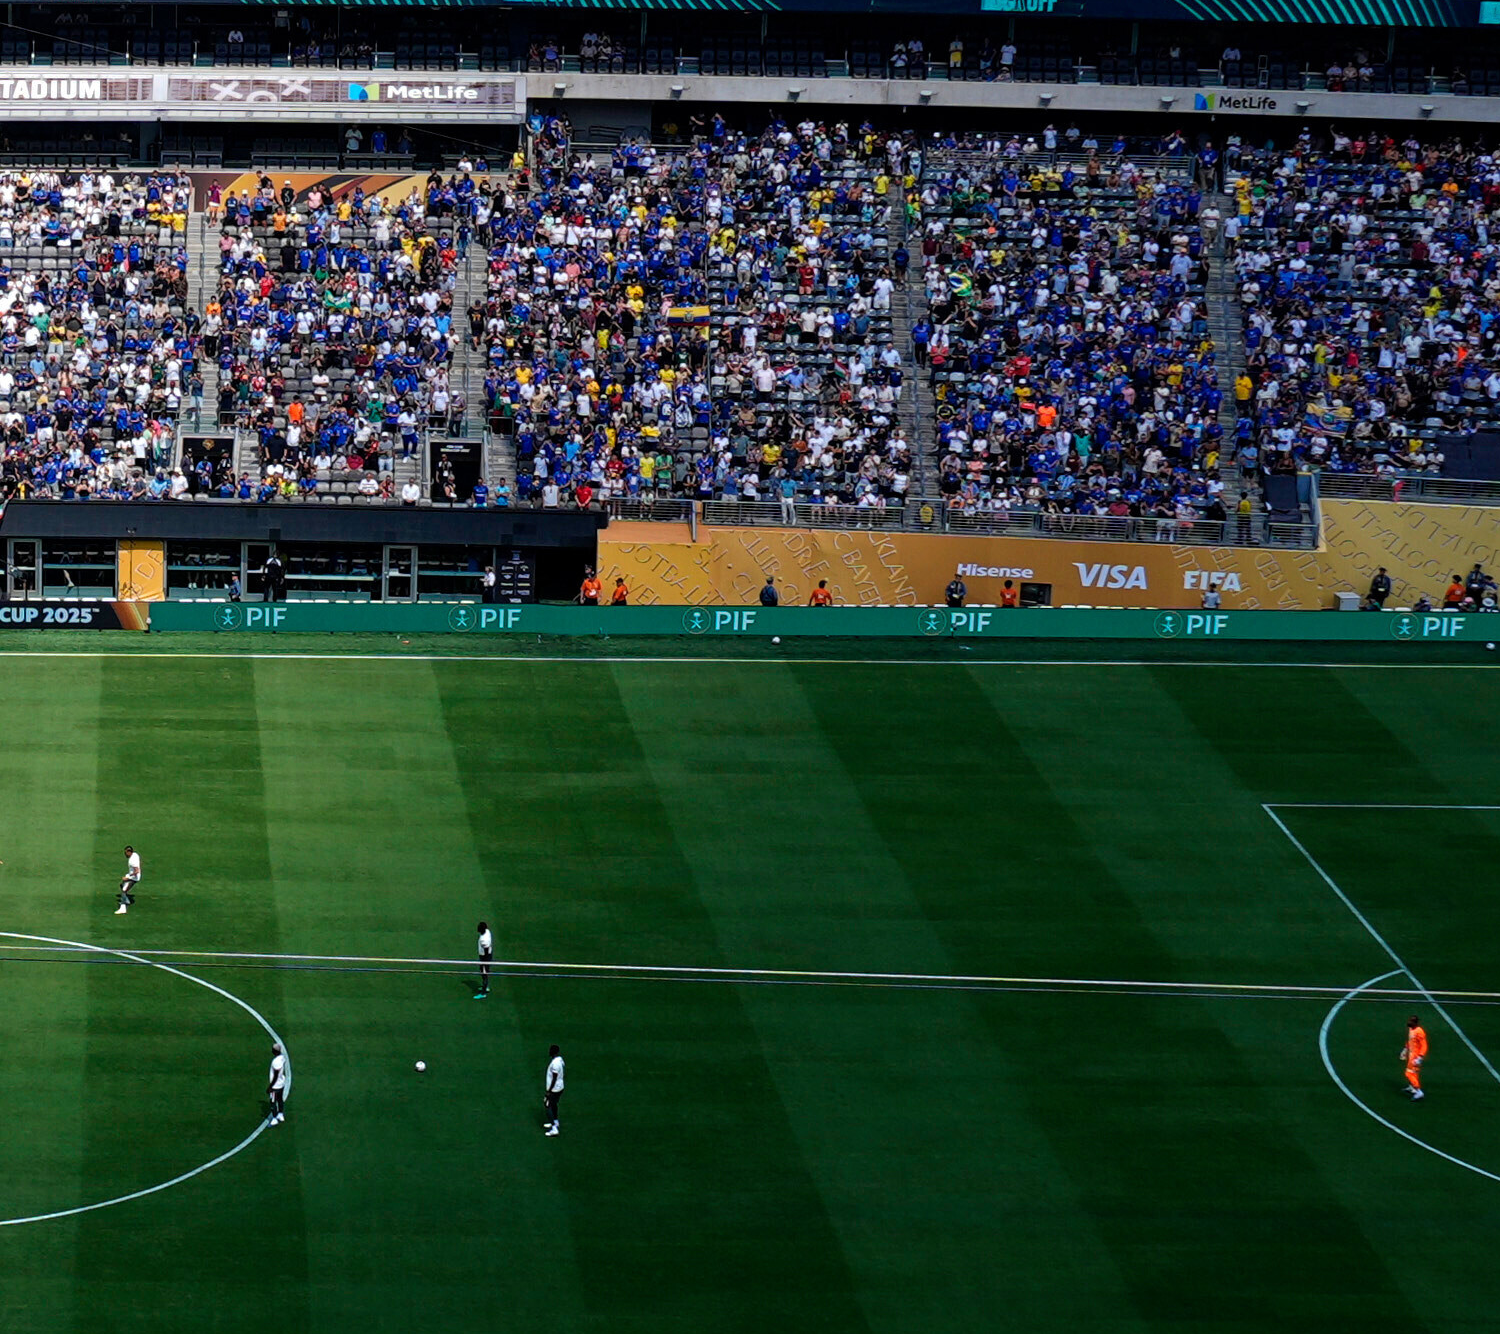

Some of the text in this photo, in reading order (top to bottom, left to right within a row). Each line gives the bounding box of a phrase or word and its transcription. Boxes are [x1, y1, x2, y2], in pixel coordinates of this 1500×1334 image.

[386, 85, 479, 99] MetLife
[1219, 95, 1277, 110] MetLife
[956, 562, 1033, 579] Hisense
[1072, 562, 1149, 590] VISA
[246, 607, 287, 627] PIF
[481, 608, 522, 628] PIF
[715, 611, 757, 631] PIF
[951, 612, 992, 632] PIF
[1187, 615, 1229, 635] PIF
[1424, 617, 1466, 637] PIF
